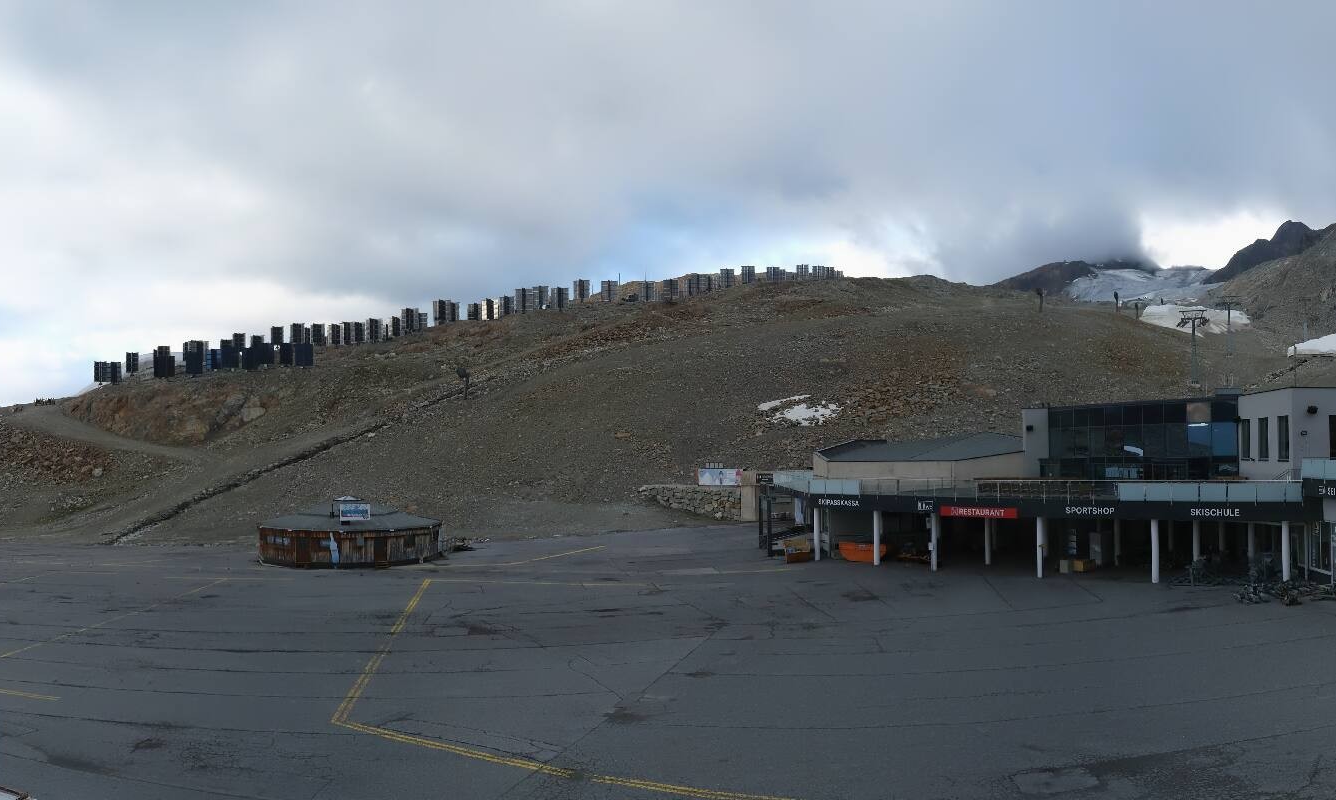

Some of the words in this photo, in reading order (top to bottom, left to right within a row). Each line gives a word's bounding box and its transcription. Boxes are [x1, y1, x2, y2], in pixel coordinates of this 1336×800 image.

[958, 507, 1005, 517] RESTAURANT
[1065, 506, 1115, 515] SPORTSHOP
[1190, 508, 1240, 517] SKISCHULE
